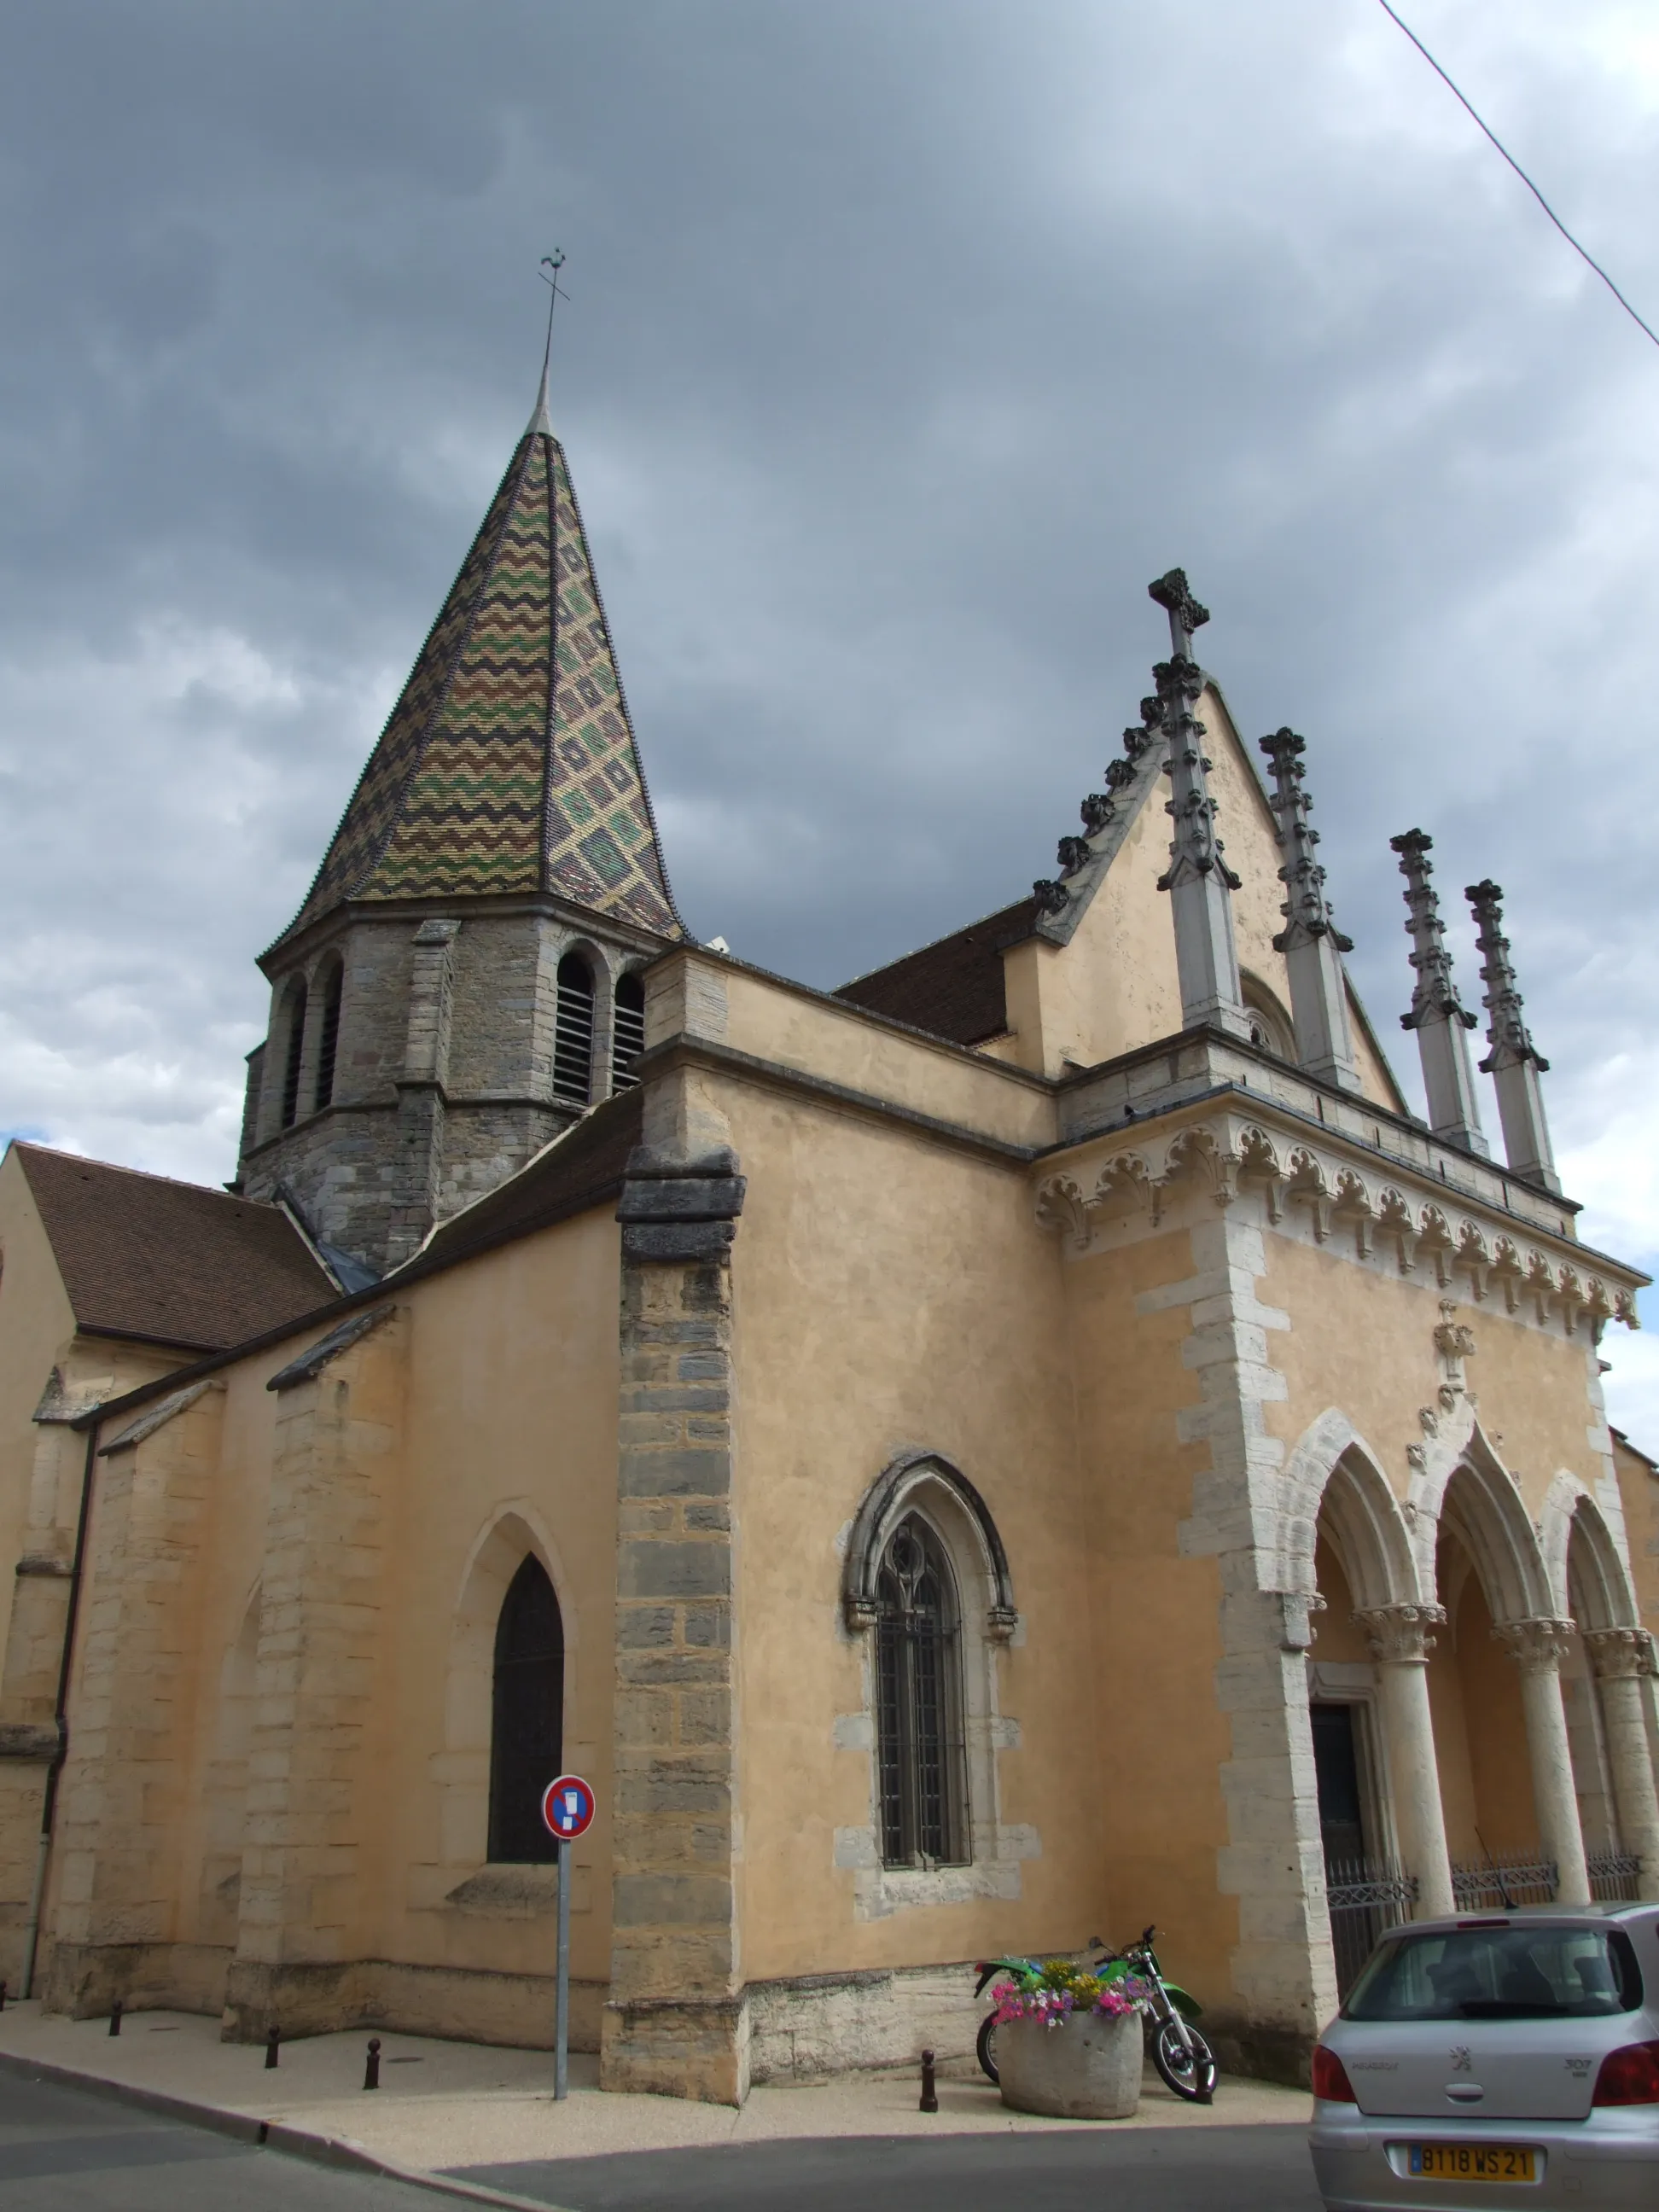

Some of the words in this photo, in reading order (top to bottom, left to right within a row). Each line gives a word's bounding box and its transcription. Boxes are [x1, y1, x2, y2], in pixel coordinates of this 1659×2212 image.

[1563, 2058, 1592, 2069] 307
[1423, 2148, 1470, 2173] 8118
[1475, 2150, 1499, 2174] WS
[1504, 2151, 1528, 2175] 21
